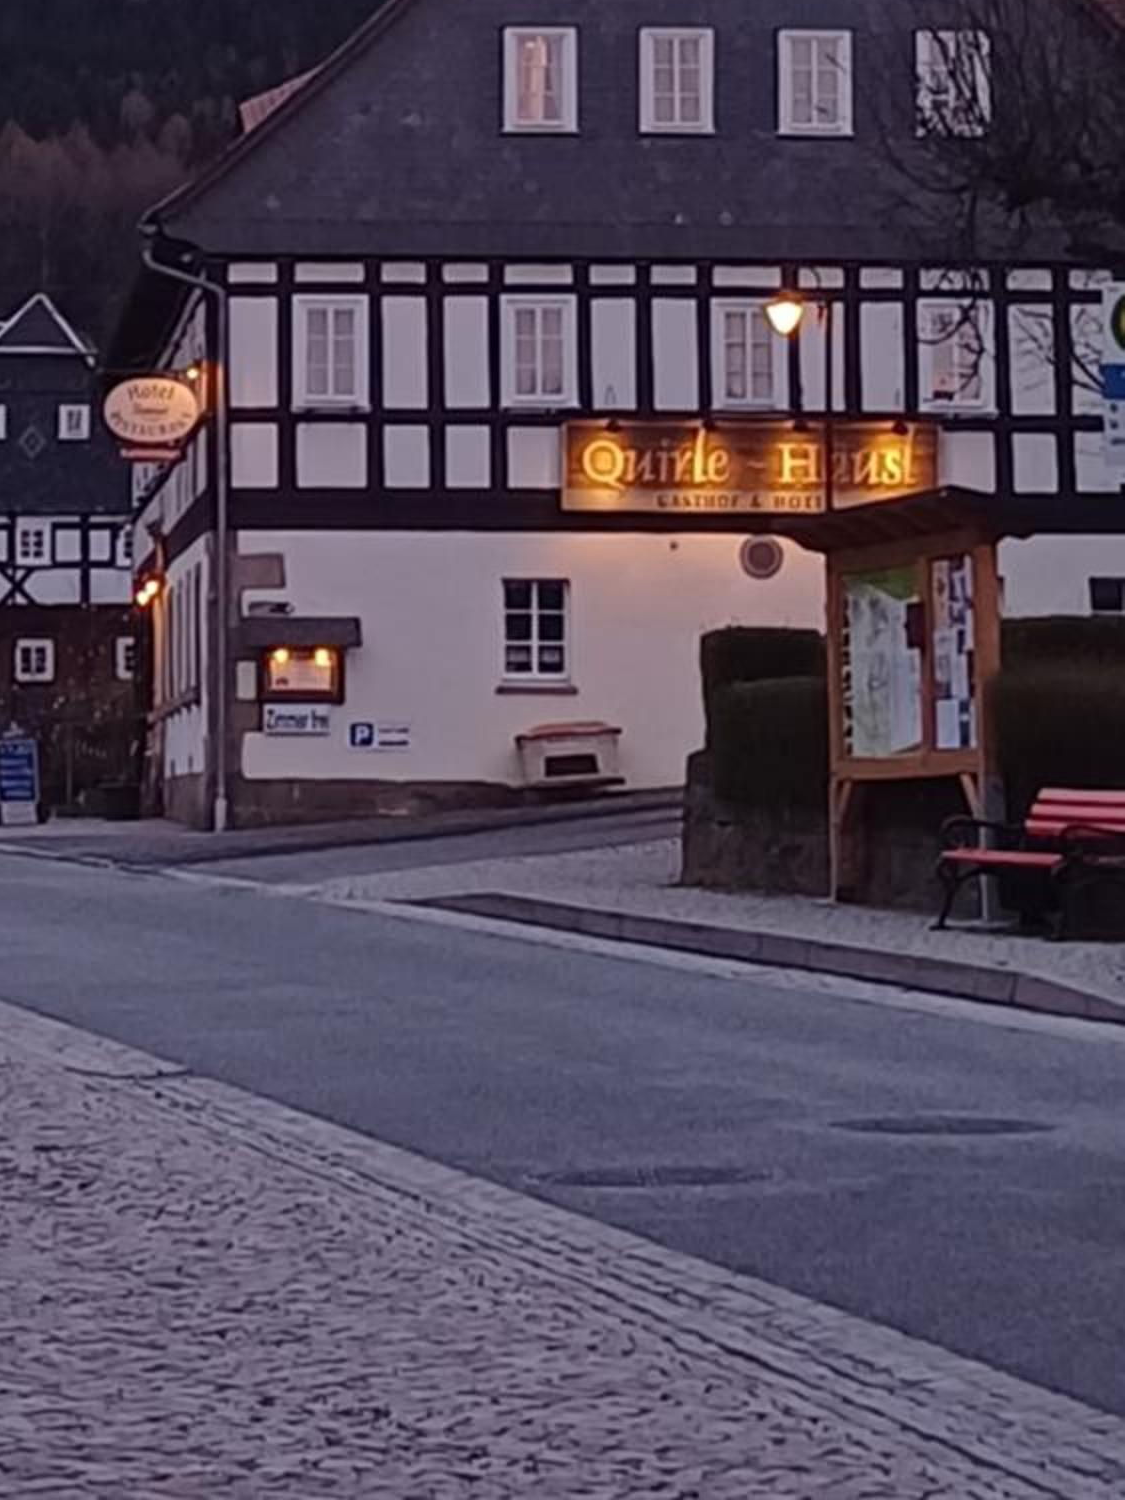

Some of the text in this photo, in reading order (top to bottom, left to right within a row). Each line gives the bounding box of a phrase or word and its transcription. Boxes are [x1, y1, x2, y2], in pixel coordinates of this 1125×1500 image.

[127, 384, 176, 401] Hotel
[582, 427, 730, 490] Quirle
[656, 494, 739, 509] GASTHOF
